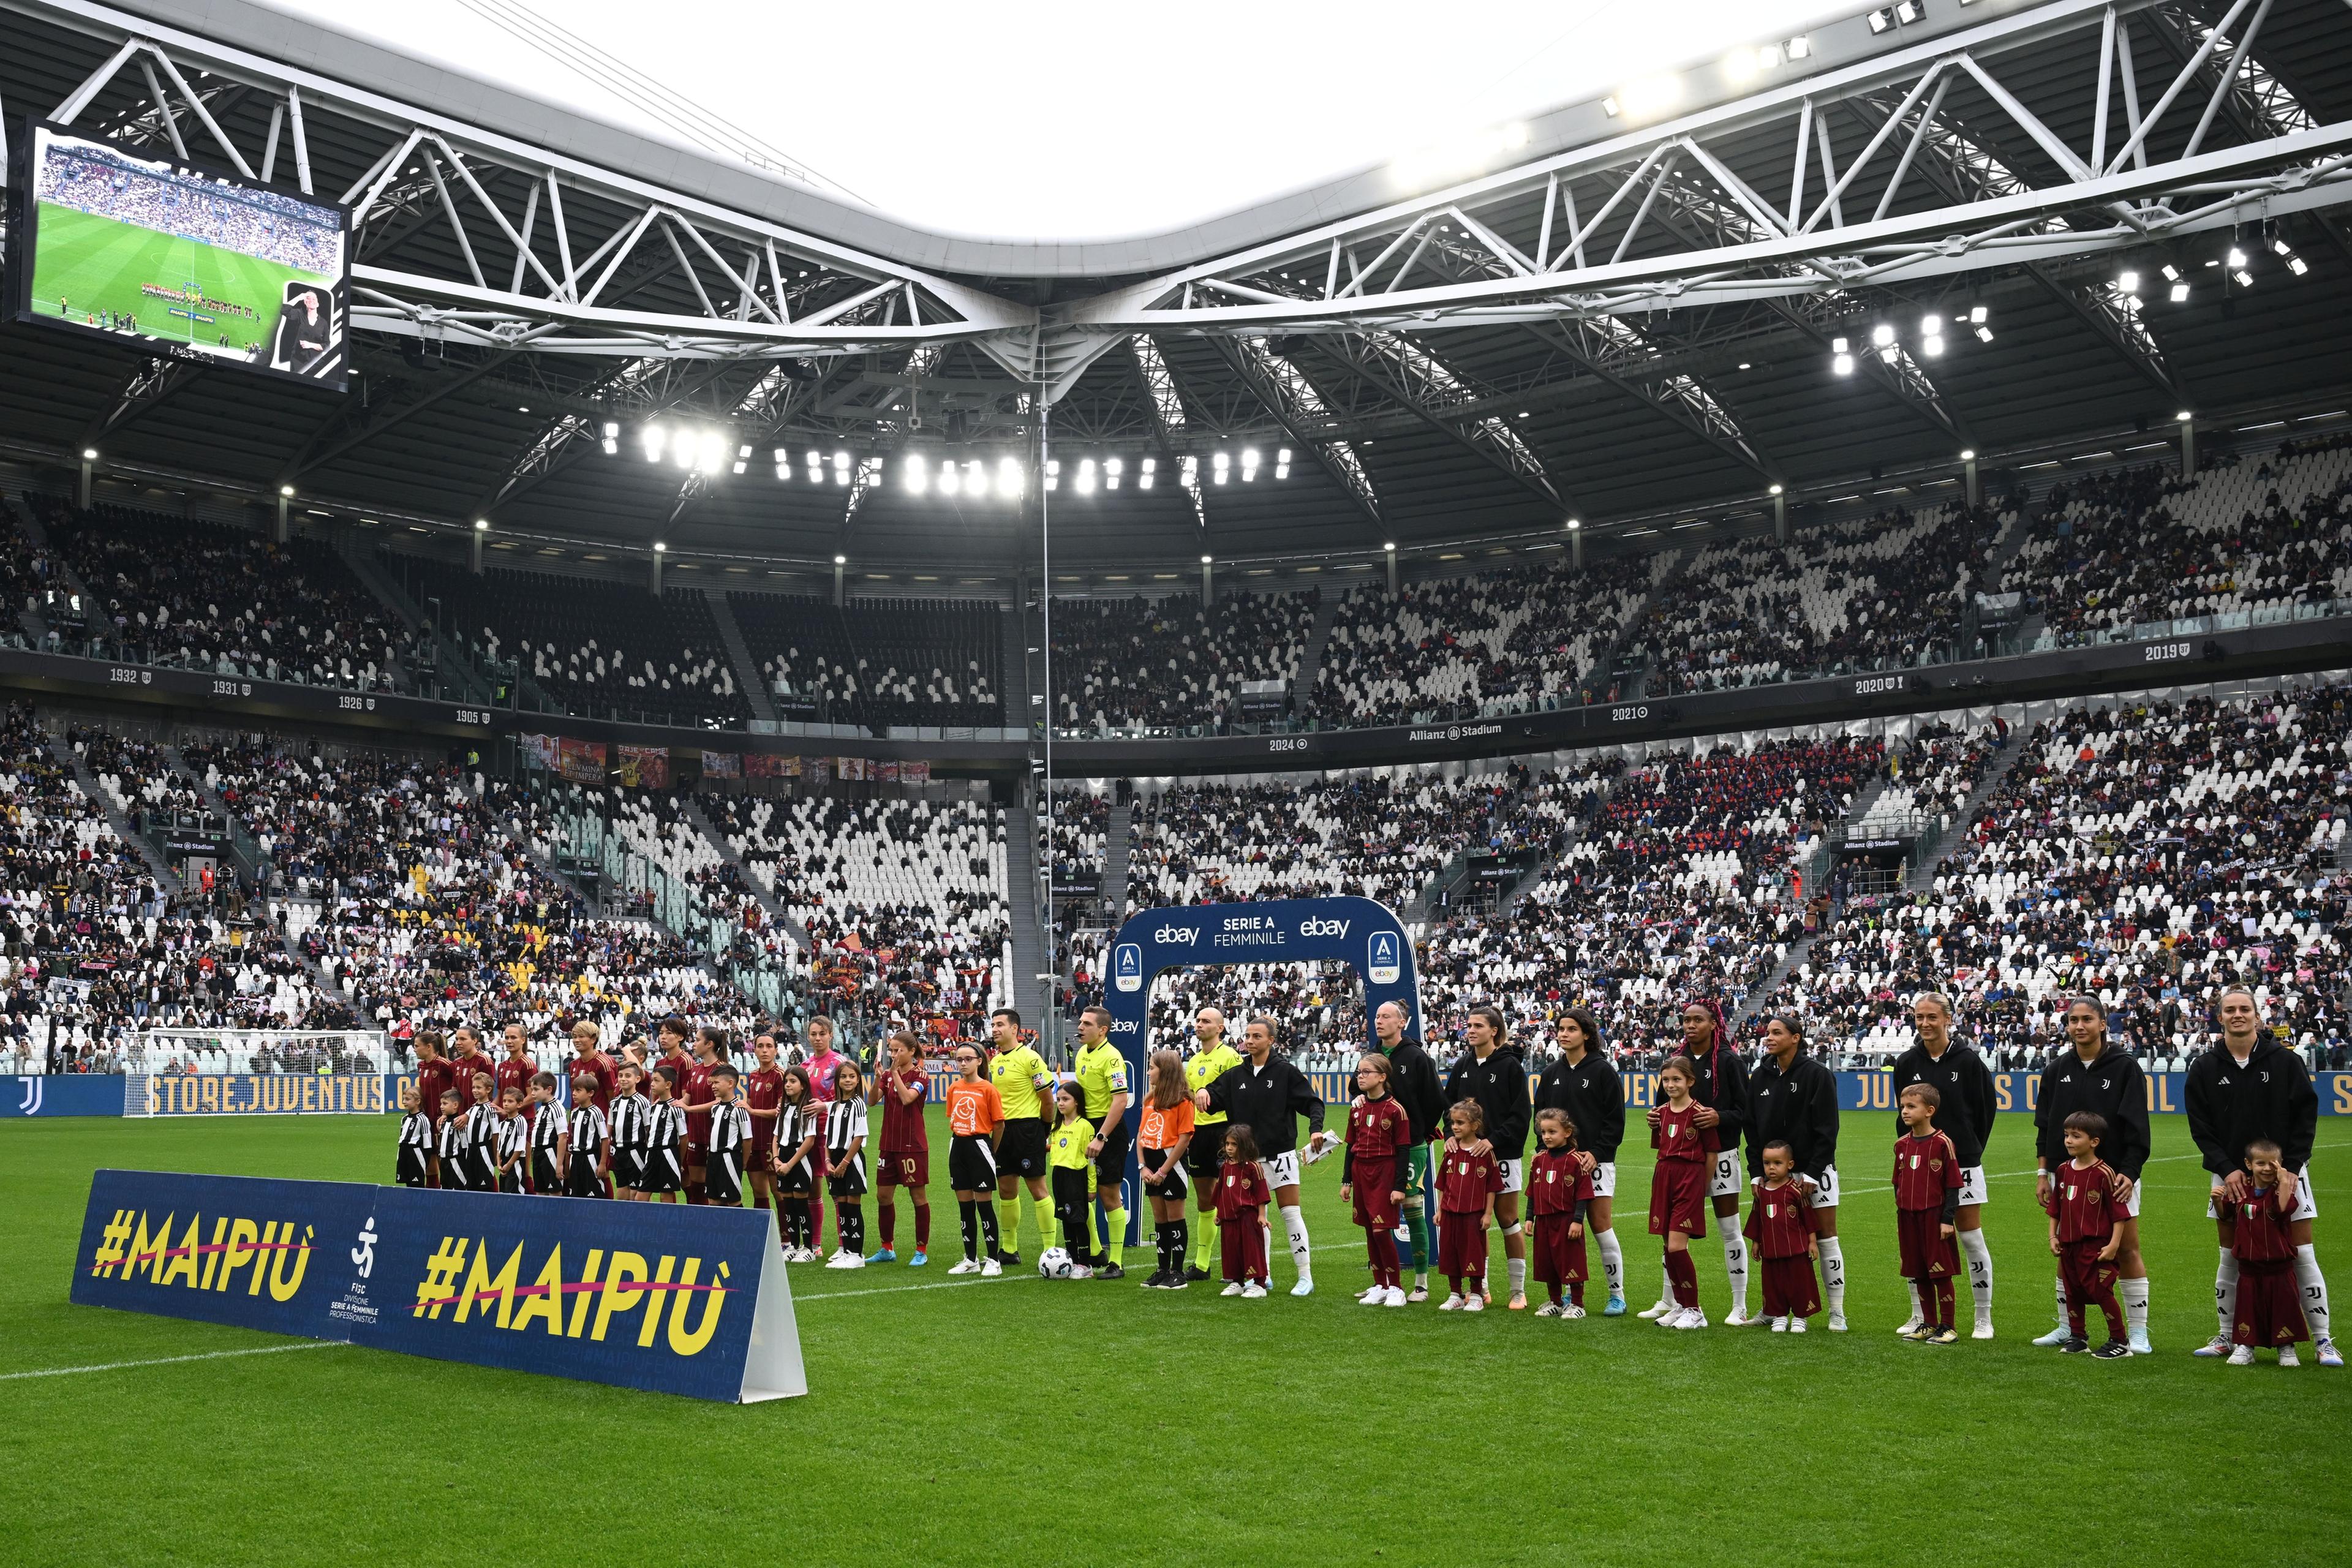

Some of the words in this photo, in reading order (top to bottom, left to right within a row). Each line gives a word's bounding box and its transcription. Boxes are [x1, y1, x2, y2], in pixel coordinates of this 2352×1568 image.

[2146, 644, 2177, 660] 2019
[110, 668, 137, 683] 1932
[213, 680, 238, 695] 1931
[1856, 679, 1884, 694] 2020
[339, 696, 362, 710] 1926
[456, 710, 478, 723] 1905
[1613, 707, 1637, 721] 2021
[1409, 729, 1446, 741] Allianz
[1462, 725, 1502, 737] Stadium
[1270, 739, 1294, 751] 2024
[1223, 918, 1261, 931] SERIE
[1265, 916, 1275, 929] A
[1300, 916, 1351, 940] ebay
[1155, 924, 1200, 947] ebay
[1214, 931, 1286, 947] FEMMINILE
[1375, 970, 1393, 978] ebay
[1110, 1020, 1139, 1035] ebay
[902, 1158, 916, 1174] 10
[1274, 1158, 1292, 1176] 21
[93, 1208, 314, 1303] #MAIPIÙ
[351, 1283, 366, 1294] FIGC
[344, 1294, 369, 1306] DIVISIONE
[412, 1236, 733, 1357] #MAIPIÙ
[331, 1302, 346, 1310] SERIE
[351, 1304, 379, 1316] FEMMINILE
[330, 1310, 377, 1324] PROFESSIONISTICA
